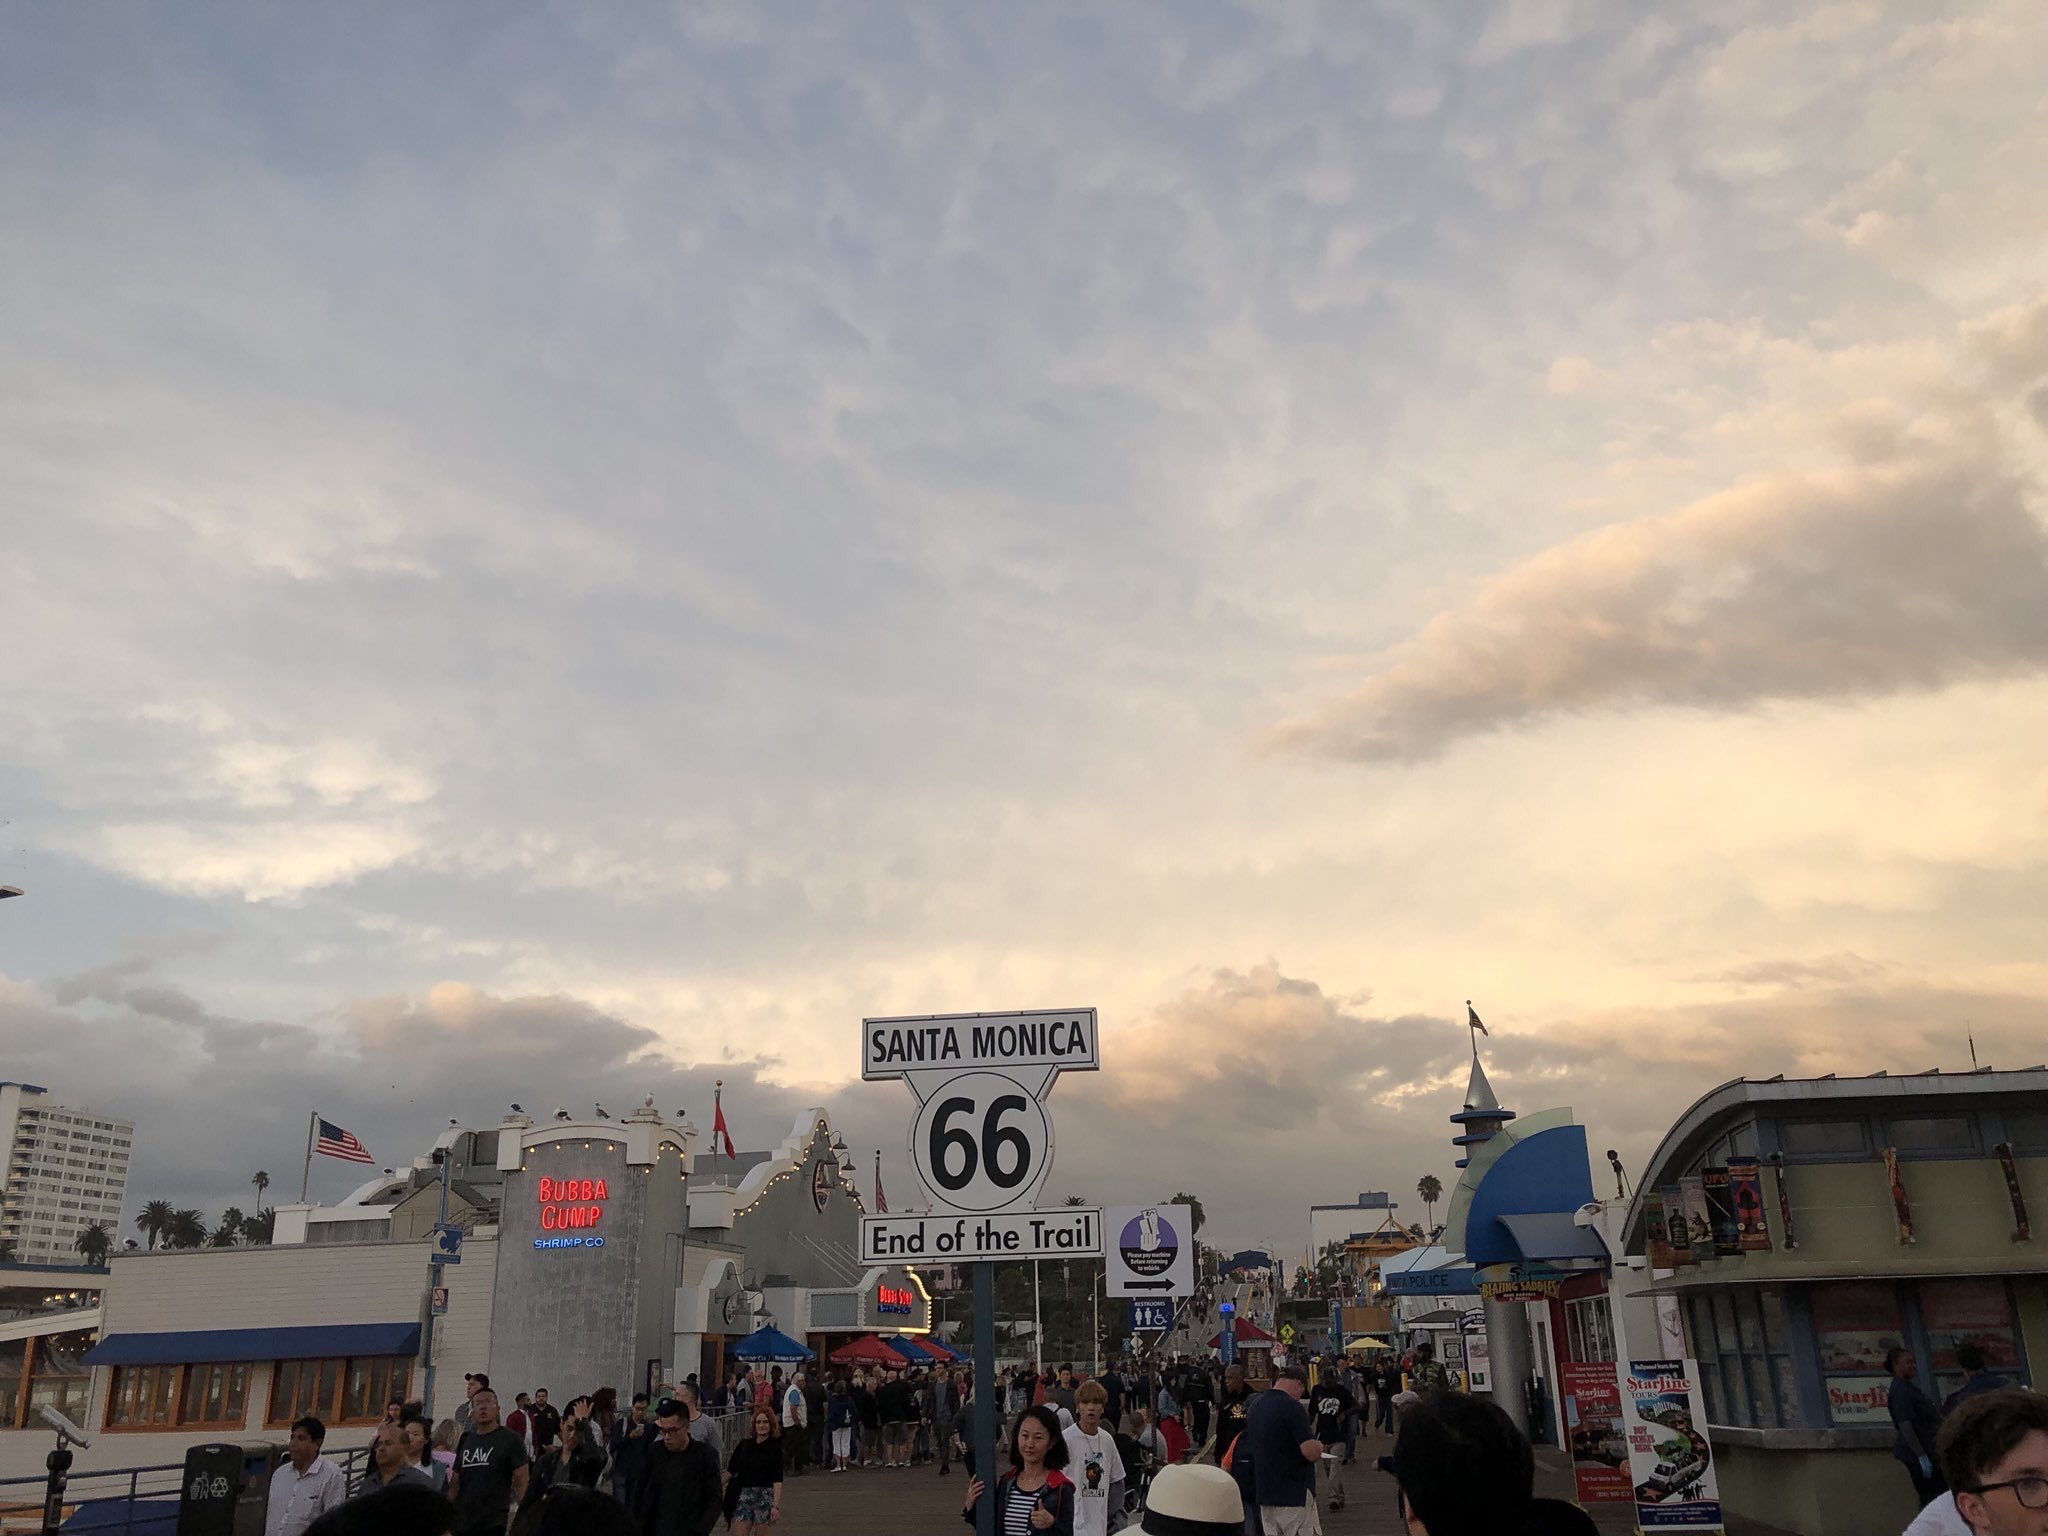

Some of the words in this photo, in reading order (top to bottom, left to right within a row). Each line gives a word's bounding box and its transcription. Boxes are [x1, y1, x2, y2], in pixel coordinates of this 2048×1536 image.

[872, 1027, 961, 1063] SANTA
[972, 1021, 1087, 1059] MONICA
[929, 1094, 1031, 1191] 66
[540, 1178, 607, 1203] BUBBA
[534, 1238, 582, 1249] SHRIMP
[585, 1237, 604, 1247] CO
[873, 1222, 925, 1255] End
[935, 1220, 966, 1252] of
[975, 1218, 1020, 1250] the
[1029, 1216, 1091, 1249] Trail
[1409, 1274, 1449, 1288] POLICE
[1481, 1281, 1518, 1298] BLAZING
[1520, 1280, 1558, 1296] SADDLES
[1631, 1391, 1658, 1399] TOURS
[1836, 1406, 1869, 1415] TOURS
[462, 1446, 495, 1465] RAW
